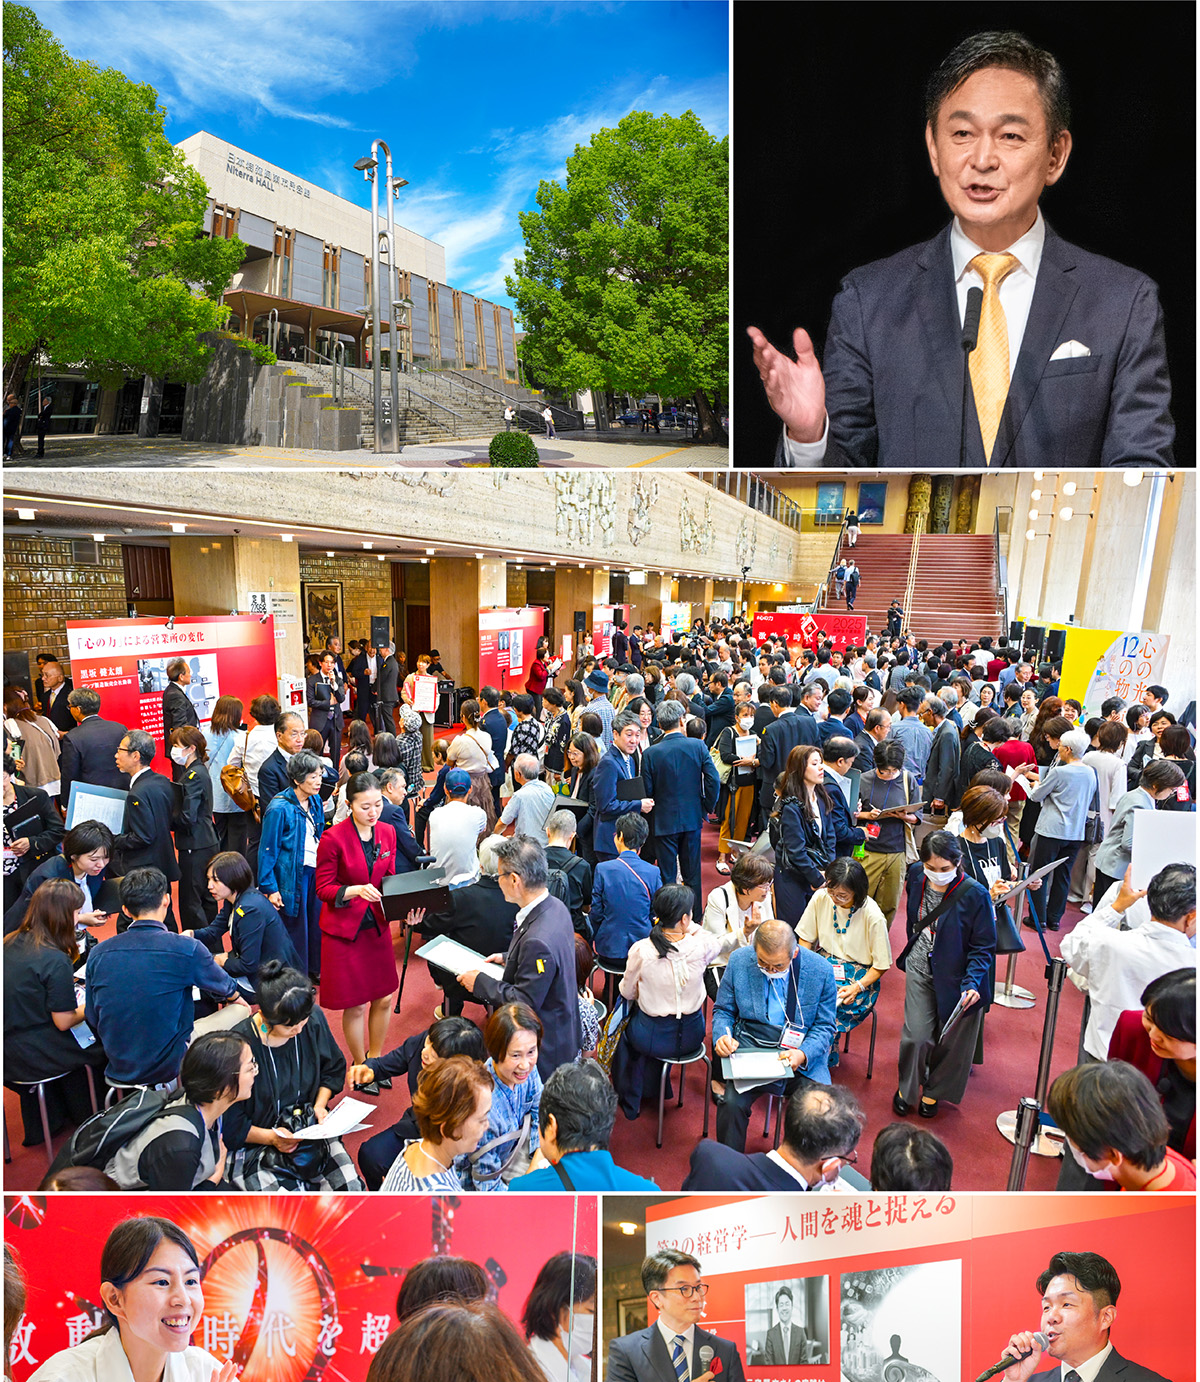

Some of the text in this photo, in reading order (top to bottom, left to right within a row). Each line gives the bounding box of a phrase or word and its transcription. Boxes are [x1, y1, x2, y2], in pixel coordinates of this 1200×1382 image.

[226, 163, 275, 192] Niterra HALL
[833, 618, 862, 629] 2025
